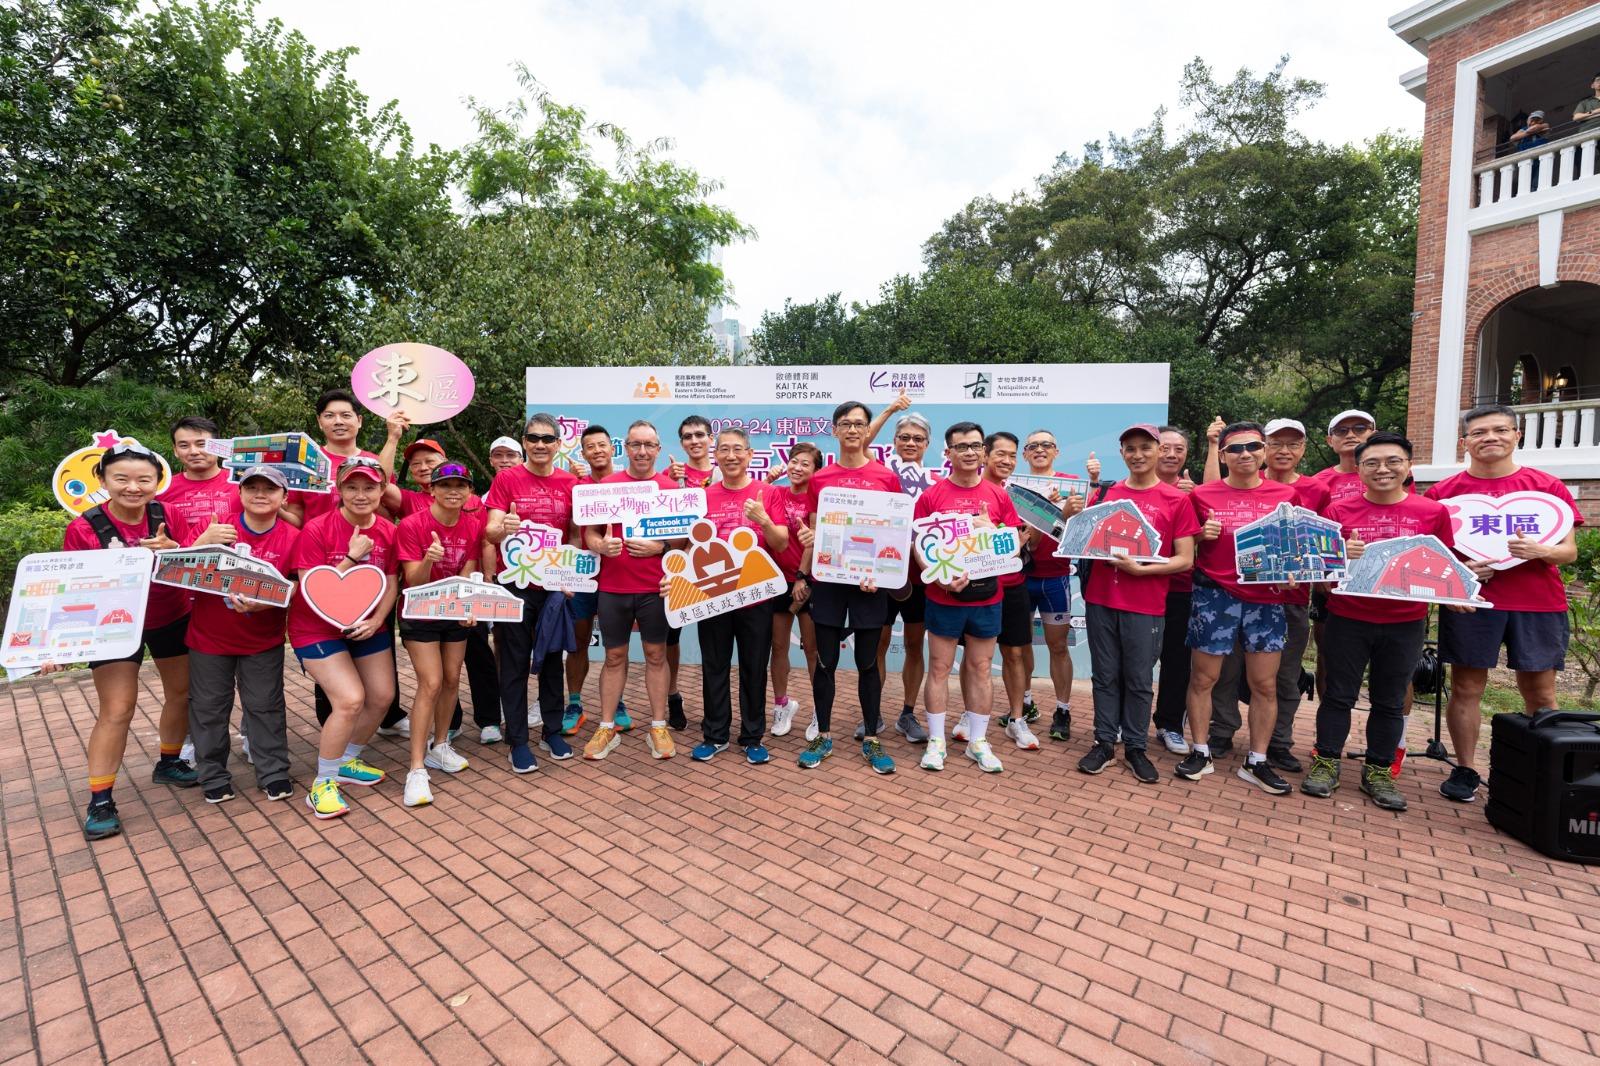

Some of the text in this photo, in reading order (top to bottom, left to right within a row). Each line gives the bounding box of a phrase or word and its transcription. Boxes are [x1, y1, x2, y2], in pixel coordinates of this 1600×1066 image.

[368, 351, 460, 409] 東區
[775, 382, 808, 390] KAI TAK
[775, 391, 832, 399] SPORTS PARK
[776, 418, 832, 435] 東區文
[647, 518, 681, 527] facebook
[1469, 513, 1541, 536] 東區
[964, 554, 992, 564] Eastern
[544, 568, 572, 577] Eastern
[560, 575, 584, 583] District
[679, 582, 778, 624] 東區民政事務處
